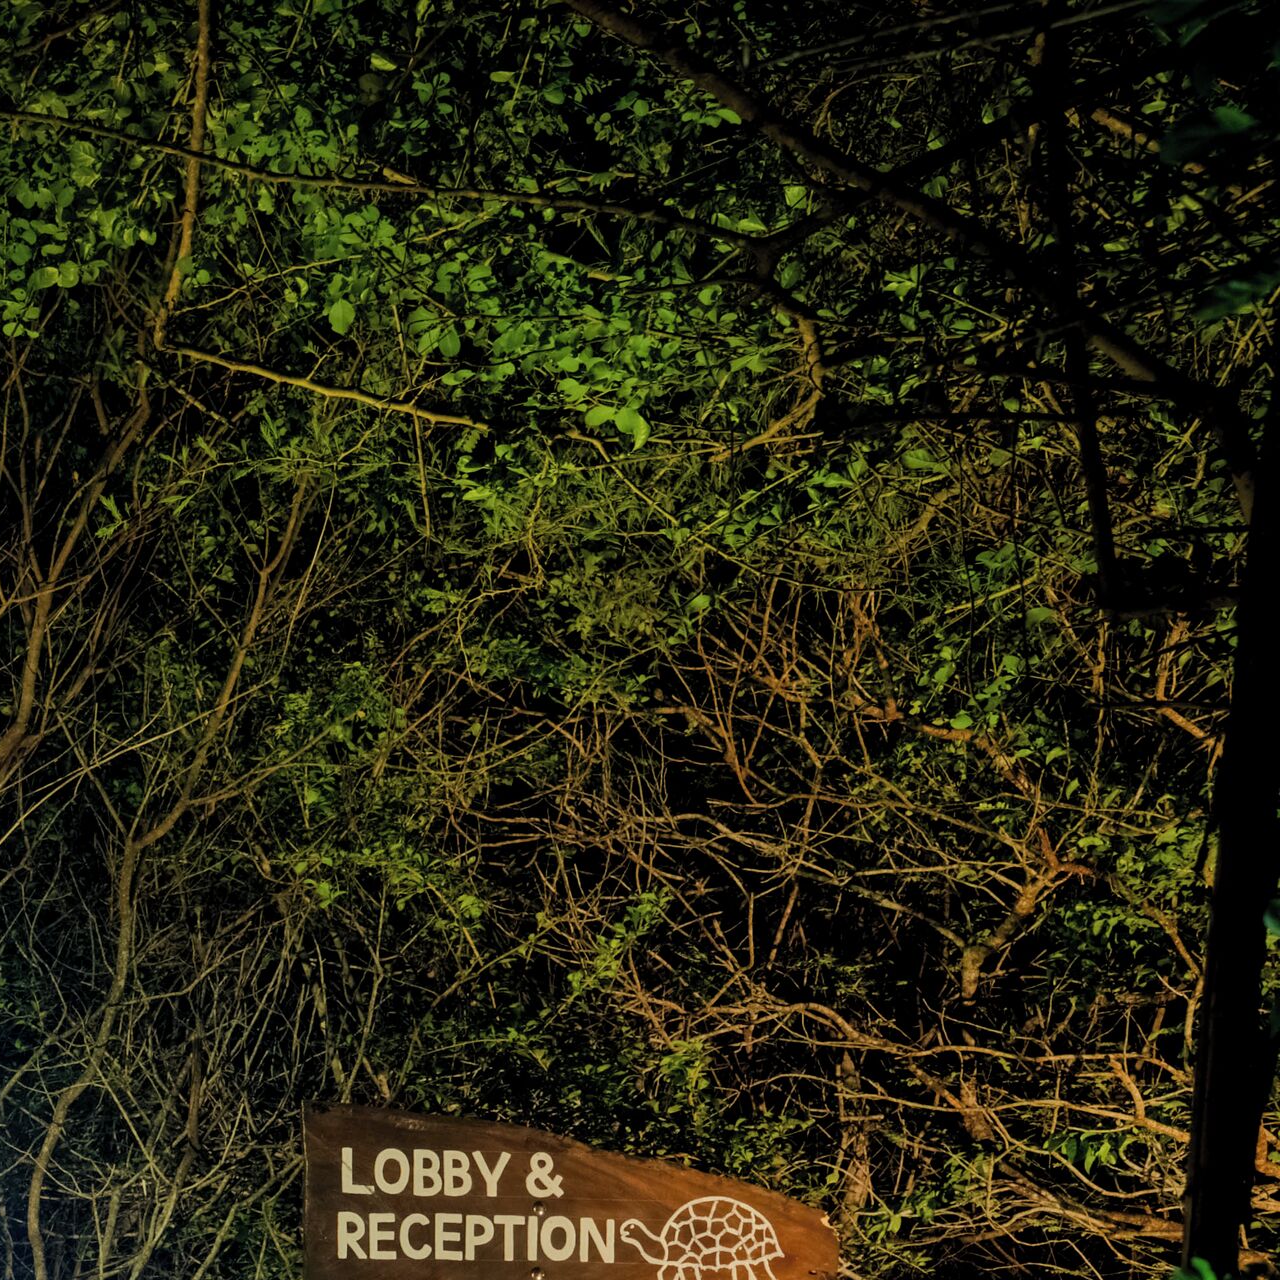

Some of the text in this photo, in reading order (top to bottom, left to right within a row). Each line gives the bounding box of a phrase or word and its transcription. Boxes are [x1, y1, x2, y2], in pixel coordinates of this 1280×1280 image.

[342, 1146, 564, 1198] LOBBY &
[337, 1212, 615, 1264] RECEPTION
